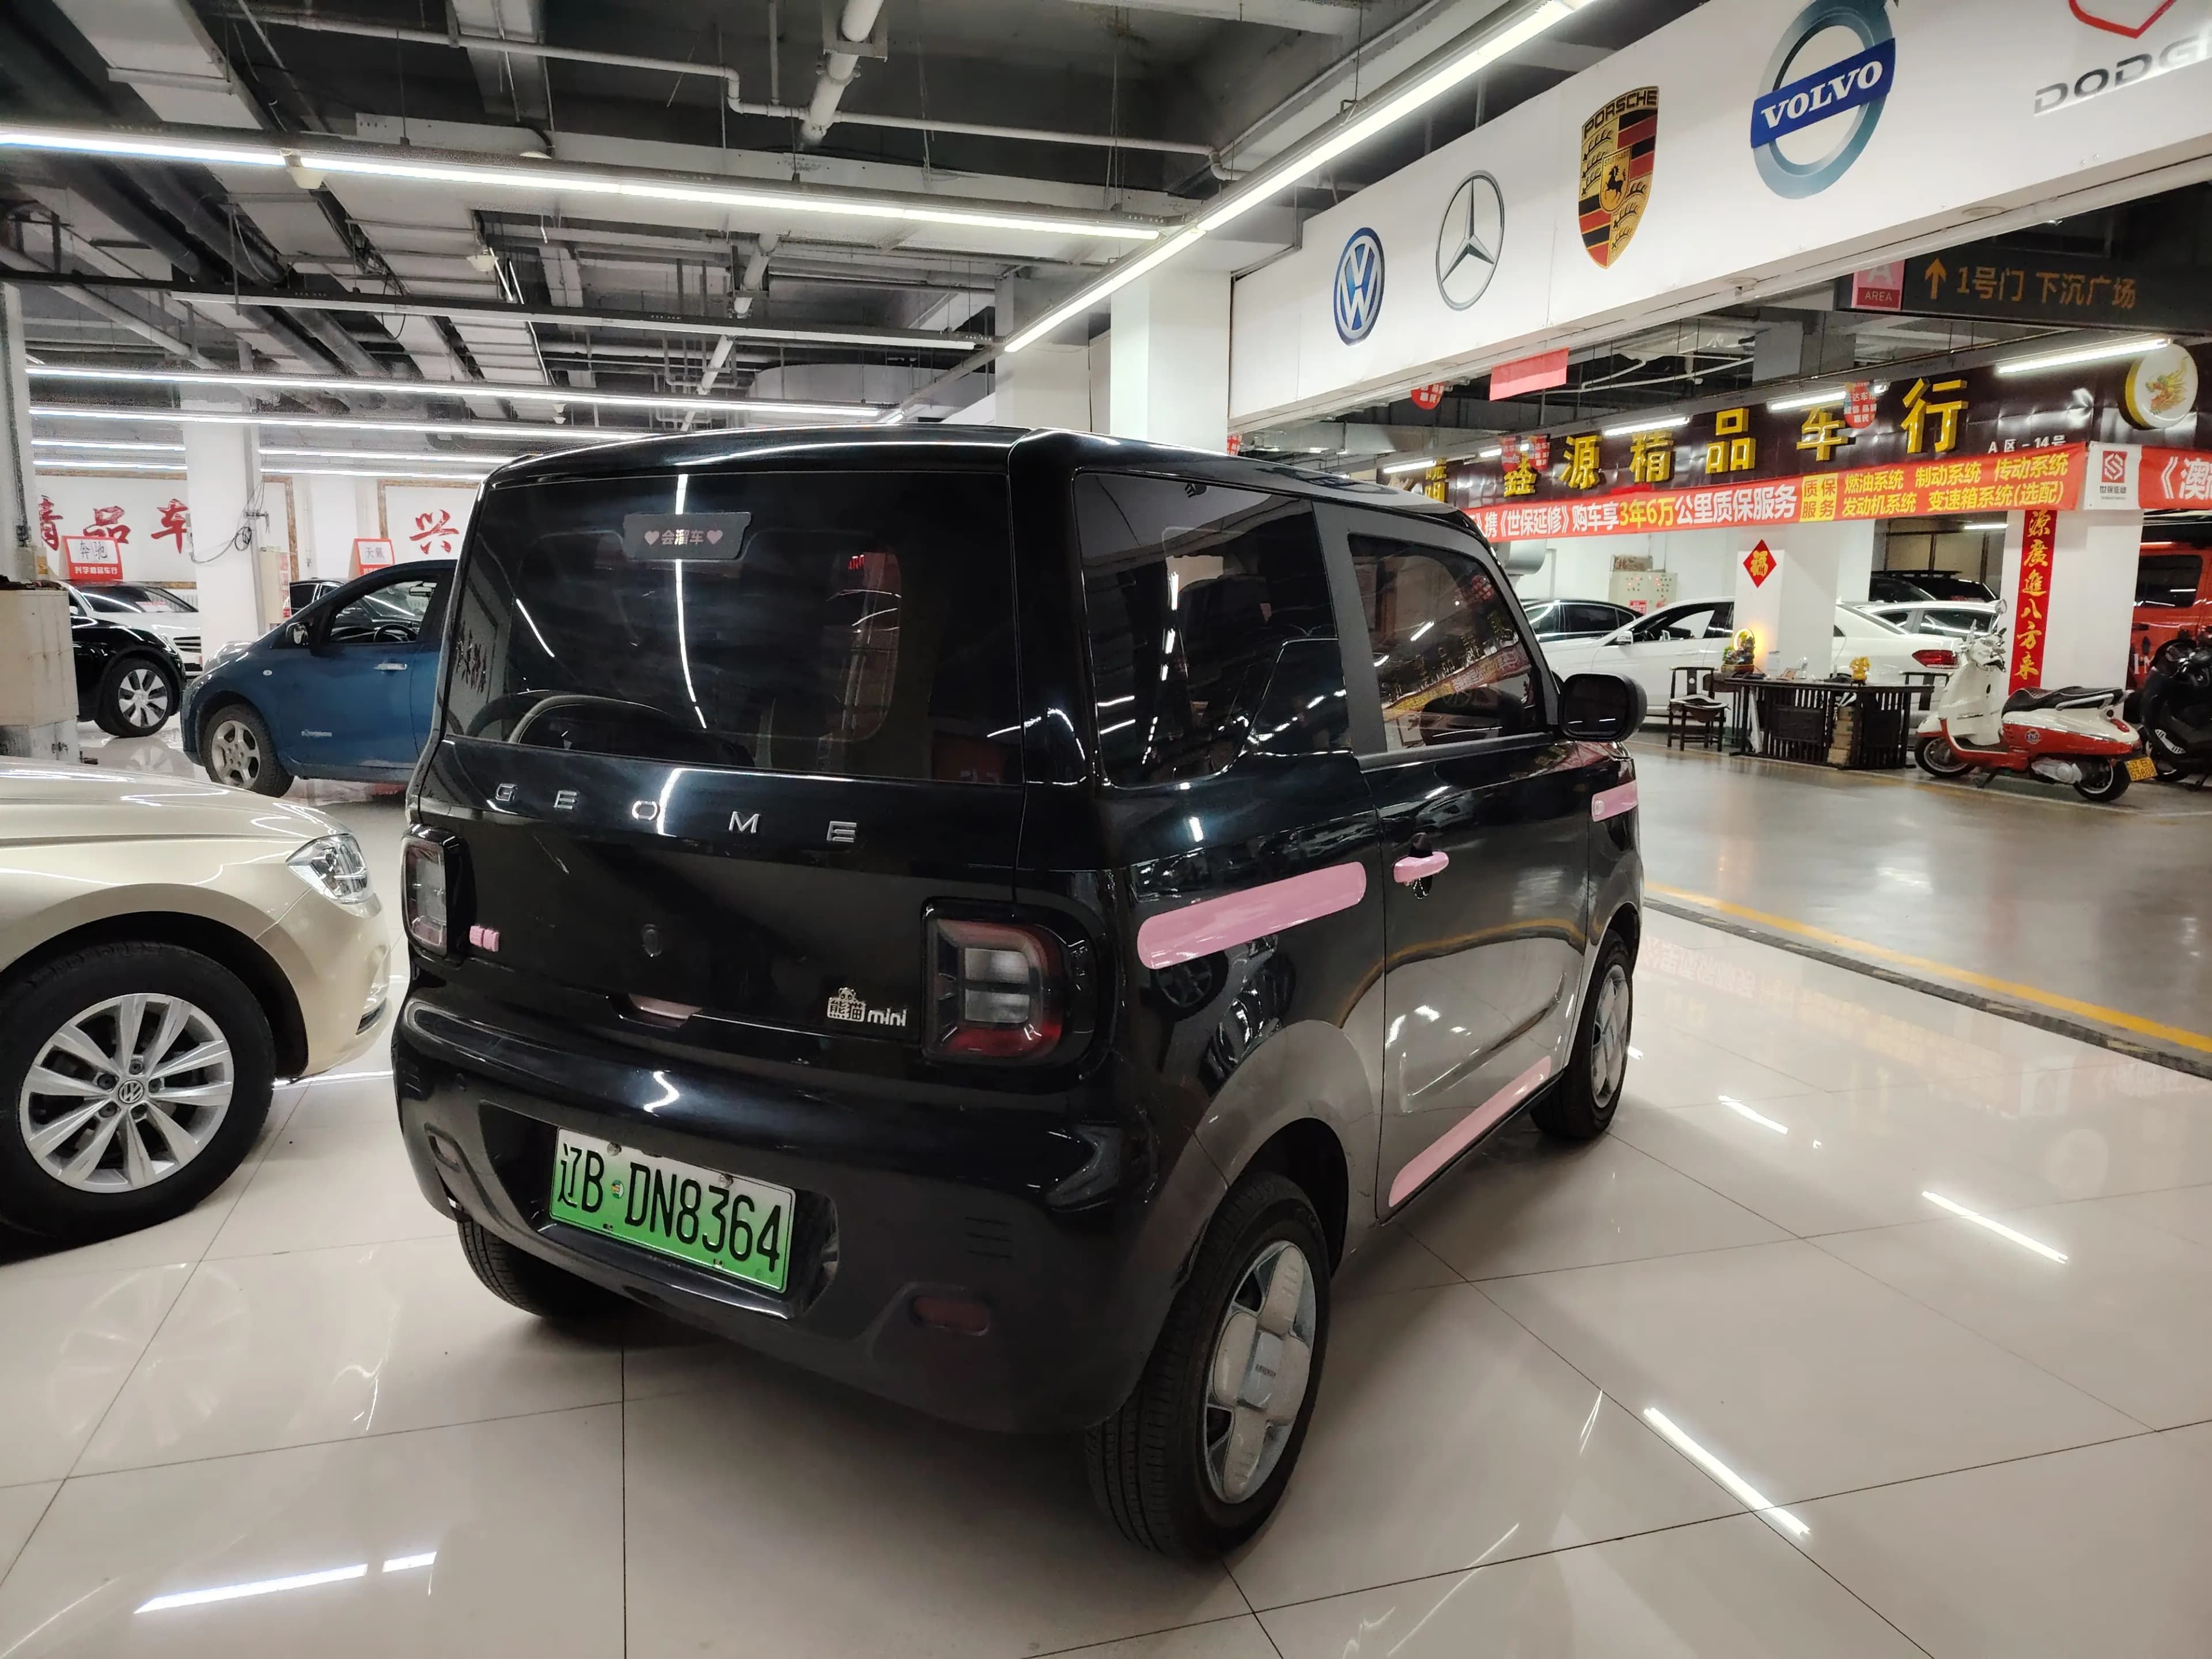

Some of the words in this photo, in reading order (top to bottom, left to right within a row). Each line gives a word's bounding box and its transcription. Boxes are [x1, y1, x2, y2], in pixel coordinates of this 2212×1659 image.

[1761, 60, 1884, 129] VOLVO
[2033, 33, 2212, 114] DODG
[1584, 89, 1658, 139] PORSCHE
[1604, 150, 1630, 166] STUTTGART
[1865, 290, 1893, 302] AREA
[1956, 266, 2025, 302] 1号门
[2035, 271, 2137, 309] 下沉广场
[1844, 470, 1904, 494] 燃油系统
[1915, 461, 1982, 488] 制动系统
[1994, 453, 2069, 482] 传动系统
[2161, 456, 2212, 501] 《澳
[1842, 492, 1917, 517] 发动机系统
[409, 509, 459, 554] 兴
[662, 529, 704, 546] 会溜车
[1750, 550, 1769, 577] 福
[495, 782, 858, 843] GEOME
[829, 999, 863, 1020] 熊猫
[867, 1006, 908, 1027] mini
[624, 1161, 782, 1273] DN8364
